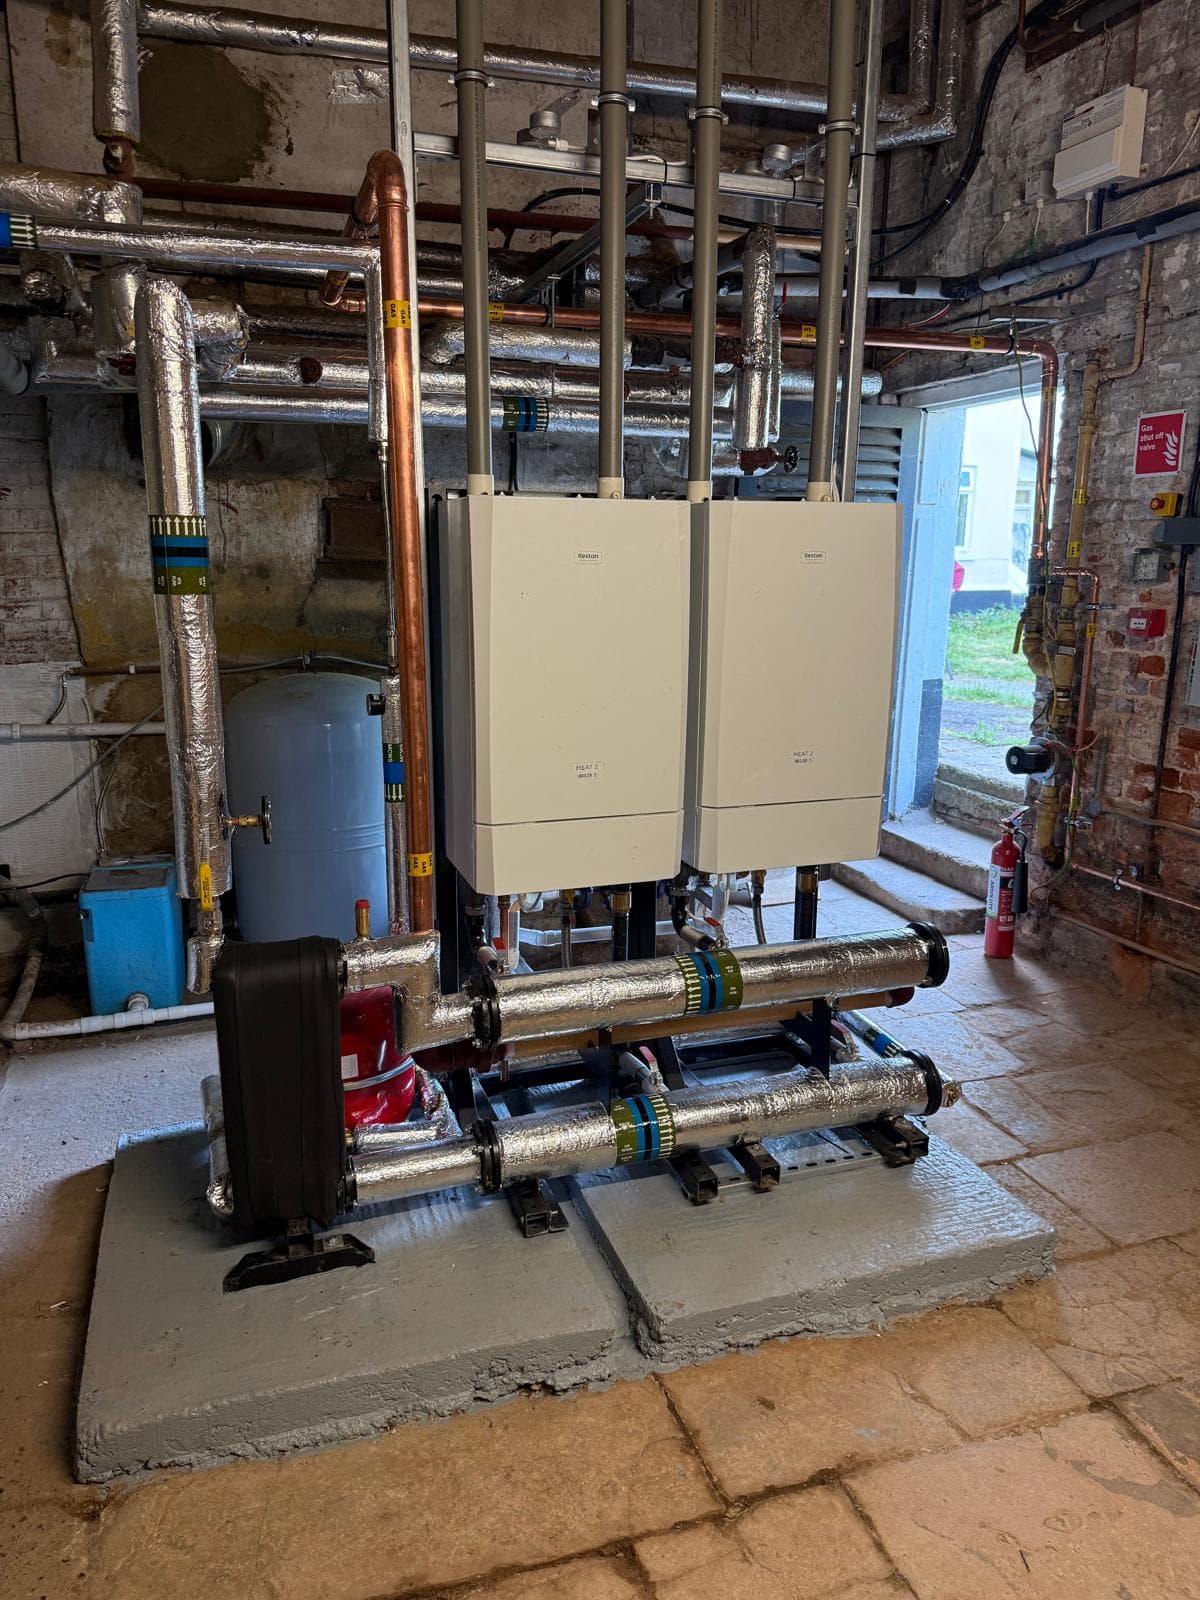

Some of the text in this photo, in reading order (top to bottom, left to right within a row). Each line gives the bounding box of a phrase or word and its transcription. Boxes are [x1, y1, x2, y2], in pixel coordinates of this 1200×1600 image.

[1141, 424, 1153, 432] Gas
[1139, 431, 1165, 442] shut off
[1138, 442, 1156, 451] valve
[575, 763, 593, 771] HEAT
